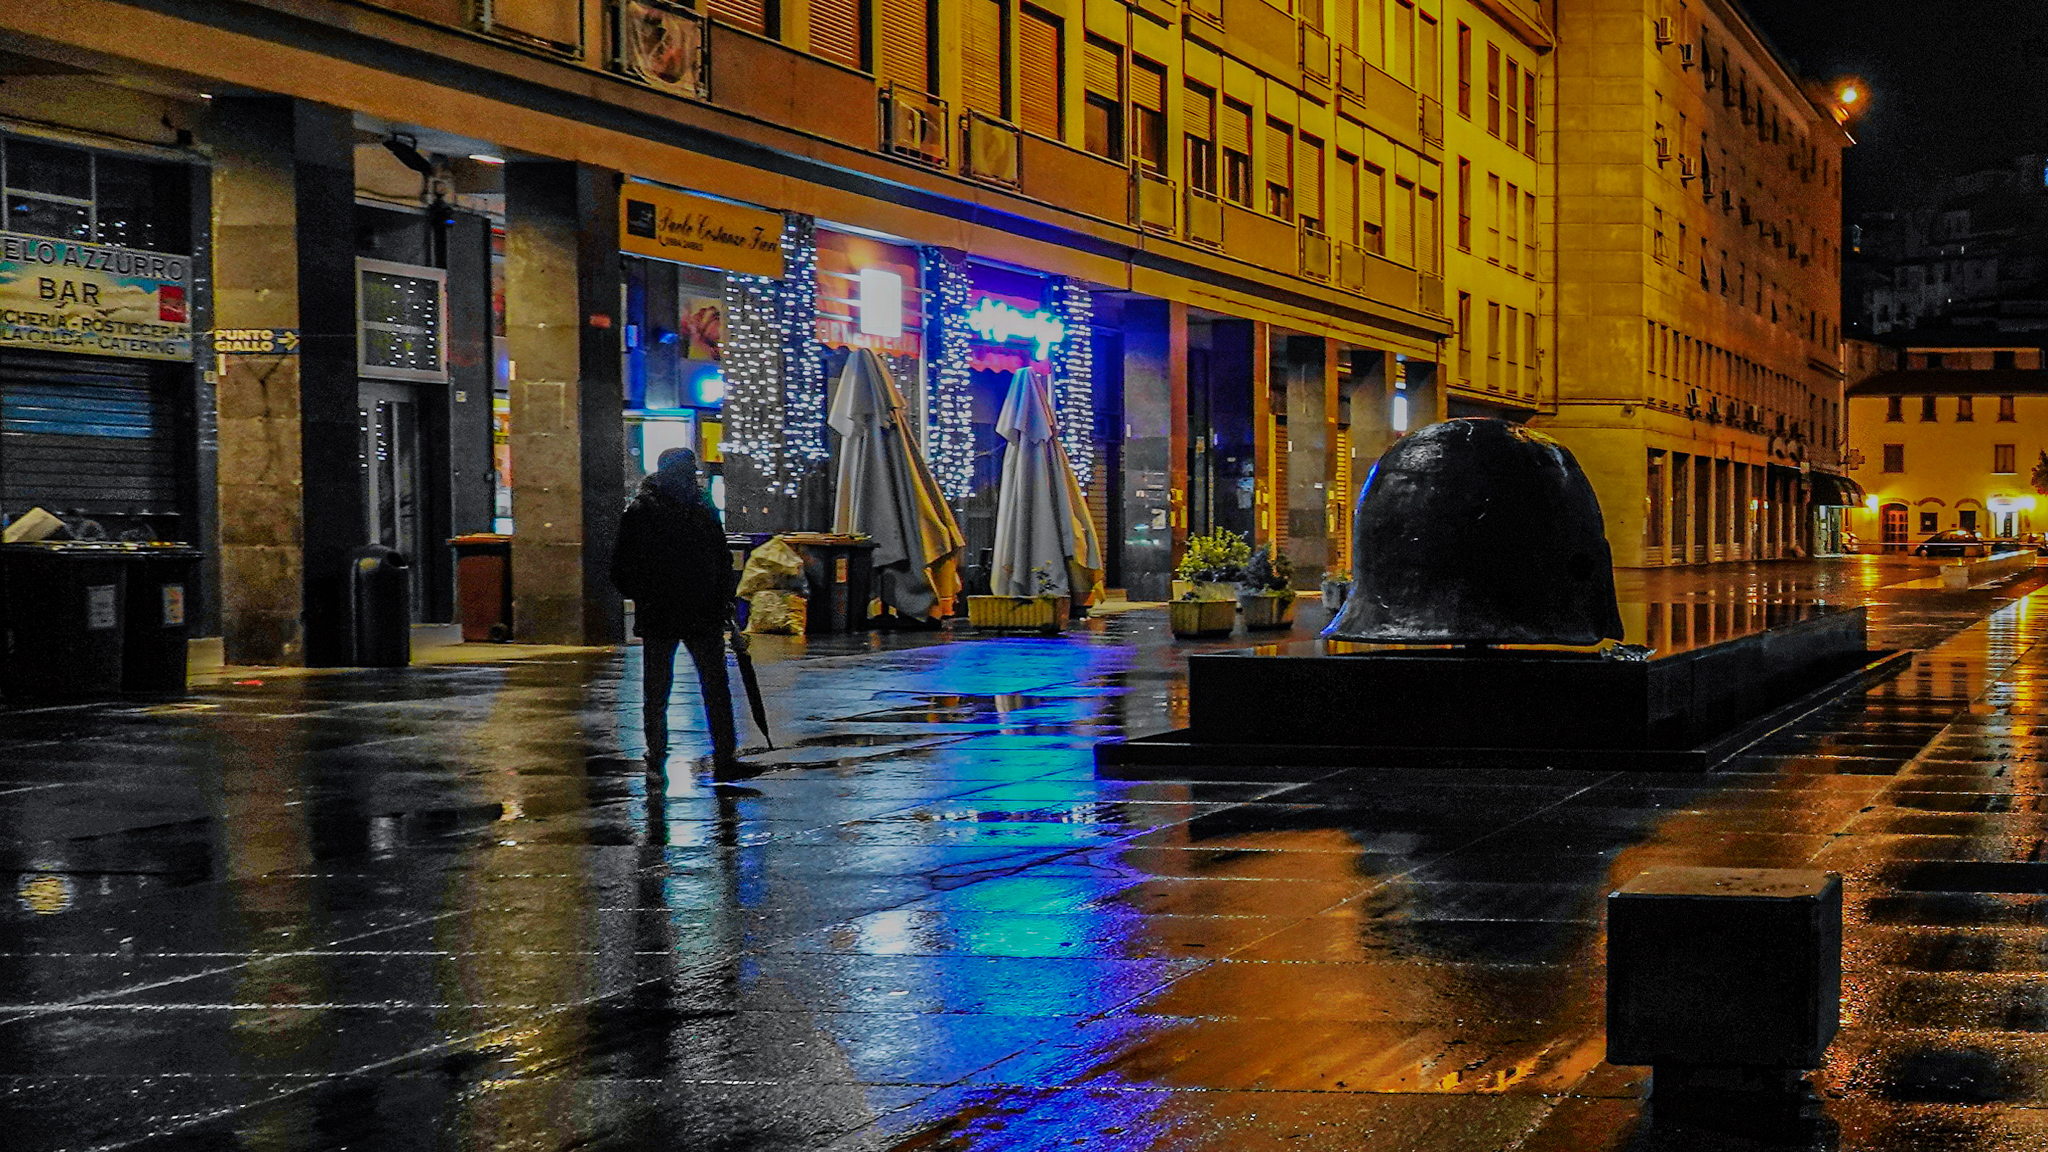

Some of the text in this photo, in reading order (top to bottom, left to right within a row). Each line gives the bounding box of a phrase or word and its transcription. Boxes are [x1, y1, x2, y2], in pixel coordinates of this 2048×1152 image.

[64, 245, 184, 281] AZZURRO
[38, 276, 99, 305] BAR
[0, 309, 68, 328] CHERIA
[82, 317, 186, 340] ROSTICCERIA
[213, 329, 275, 341] PUNTO
[28, 329, 83, 346] CALDA
[99, 335, 176, 355] CATERING
[213, 340, 275, 352] GIALLO
